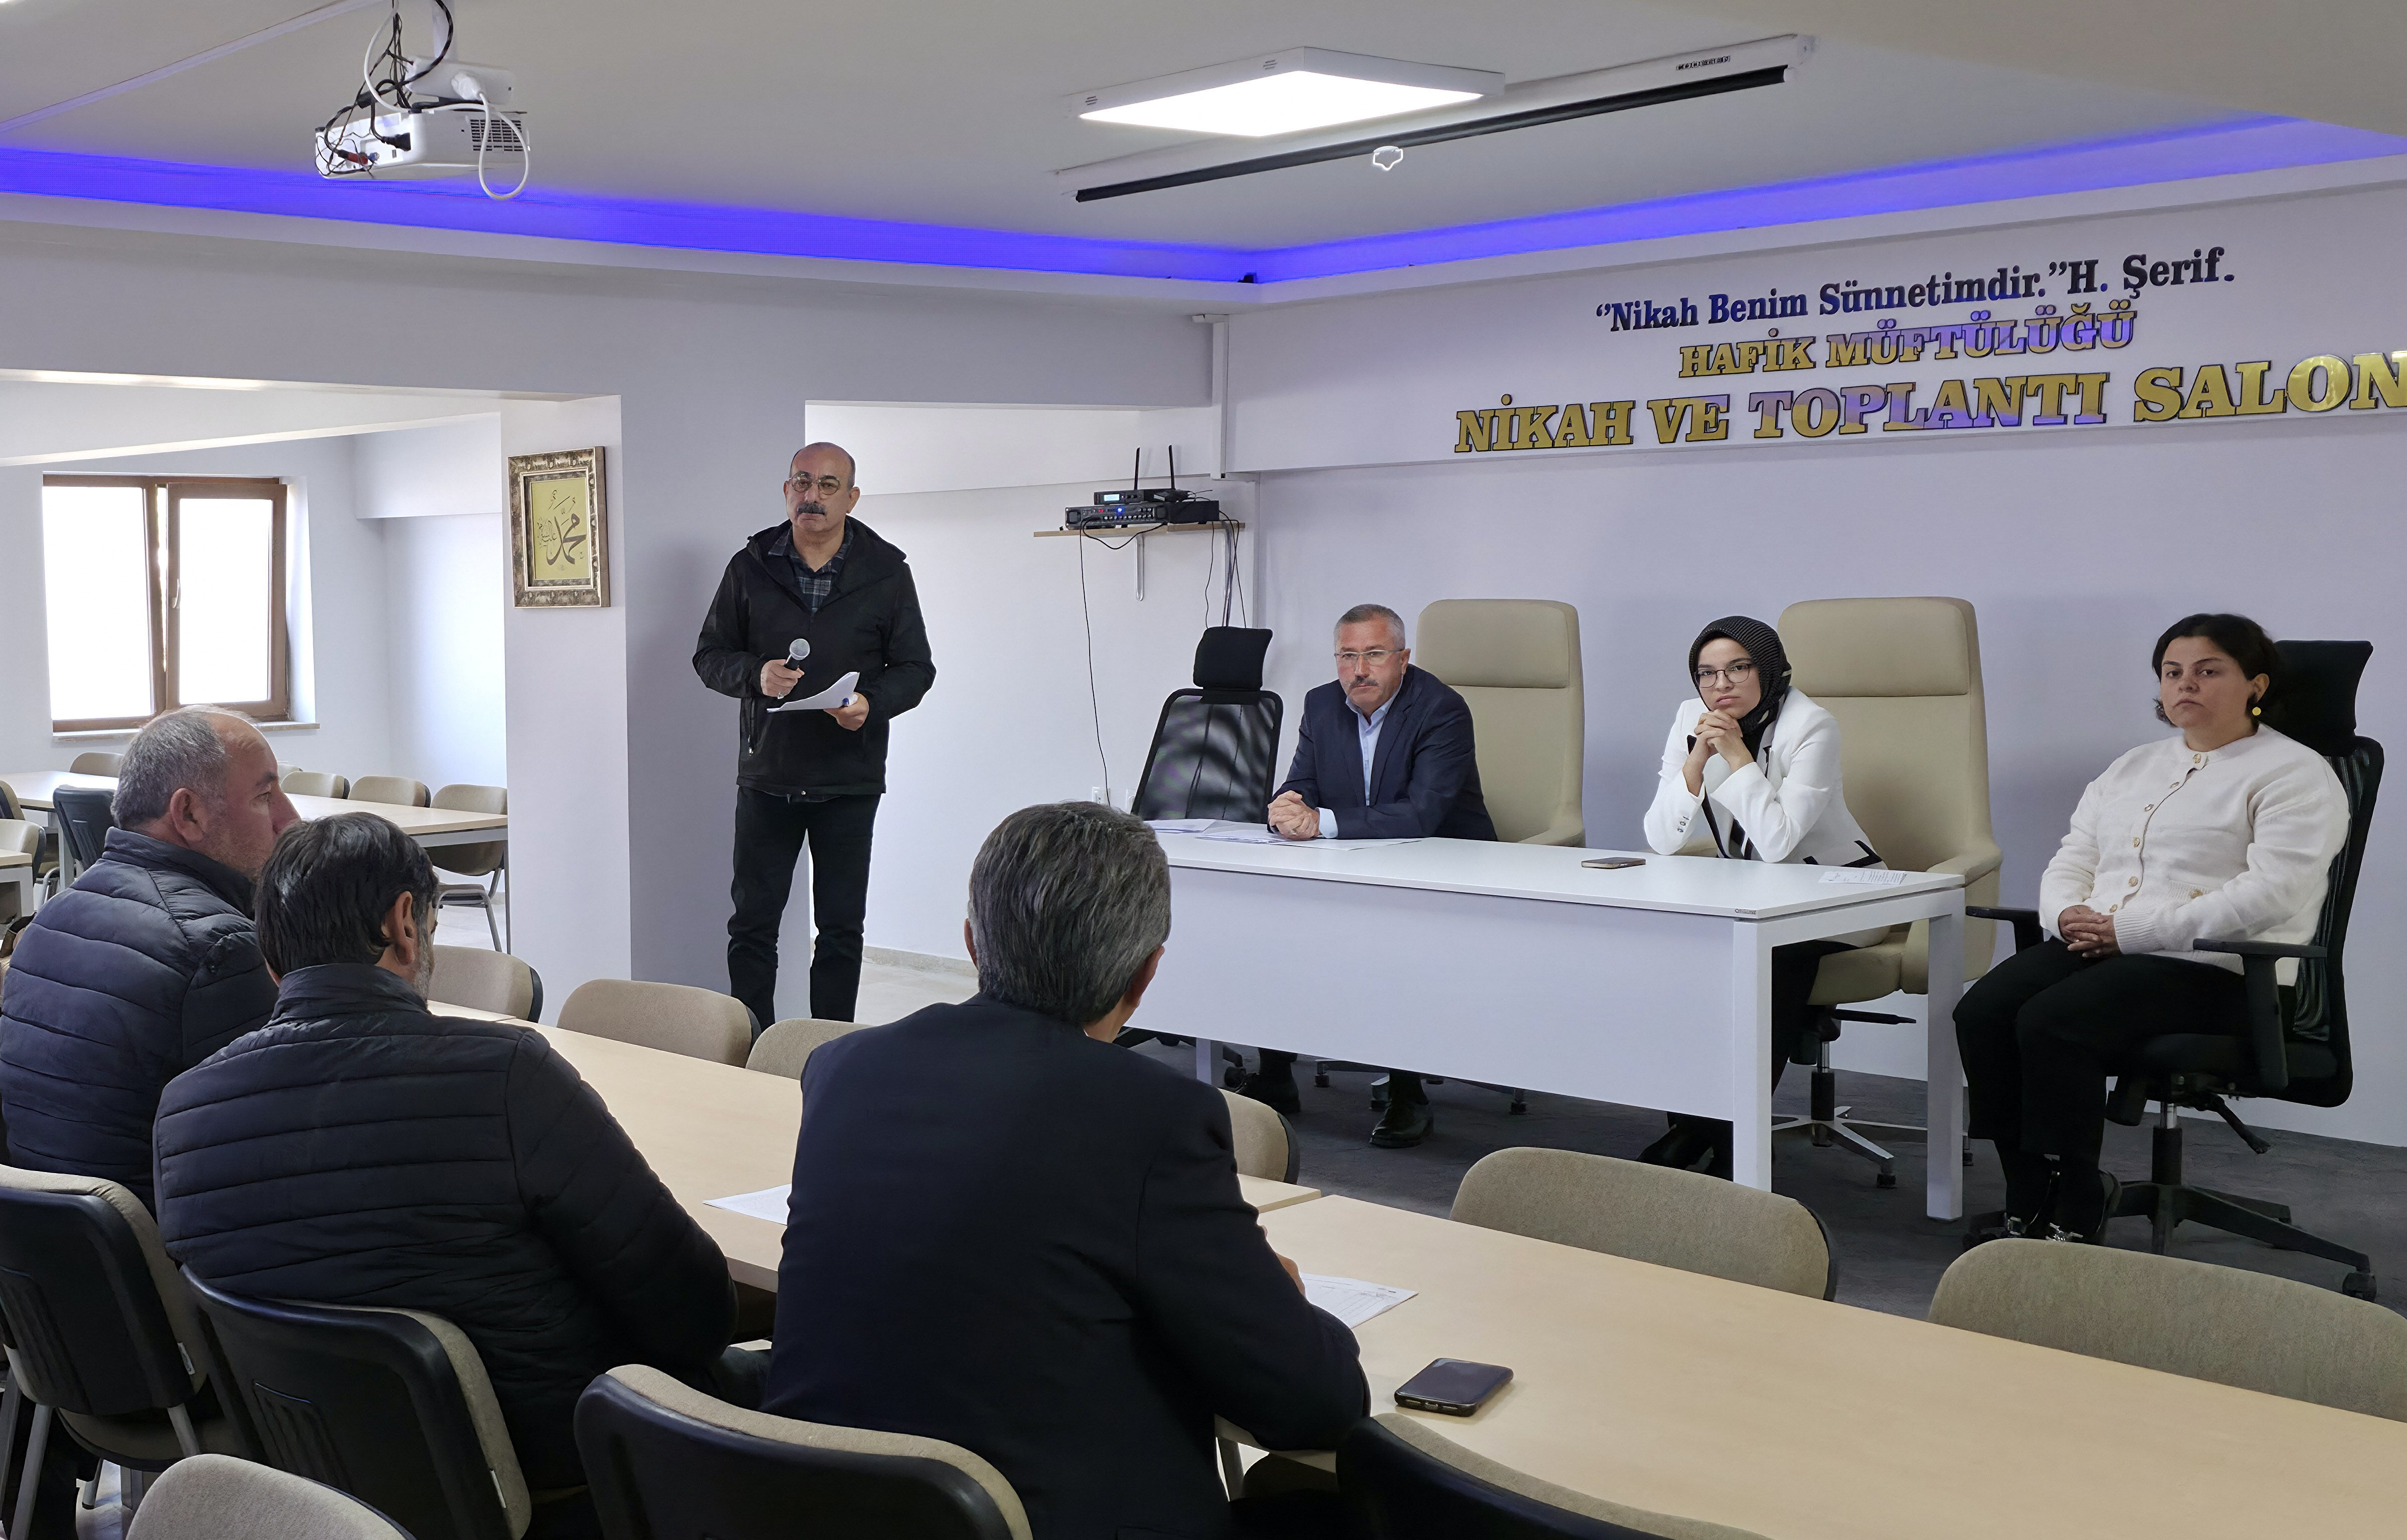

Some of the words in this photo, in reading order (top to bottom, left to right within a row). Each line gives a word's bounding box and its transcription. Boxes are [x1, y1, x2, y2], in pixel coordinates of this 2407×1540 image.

[1708, 288, 1808, 324] Benim
[2123, 247, 2235, 299] Şerif.
[1679, 327, 1816, 378] HAFİK
[1825, 299, 2138, 368] MÜFTÜLÜĞÜ
[1454, 394, 1636, 453] NİKAH
[1647, 394, 1731, 444] VE
[1749, 372, 2110, 438] TOPLANTI
[2134, 351, 2407, 423] SALON
